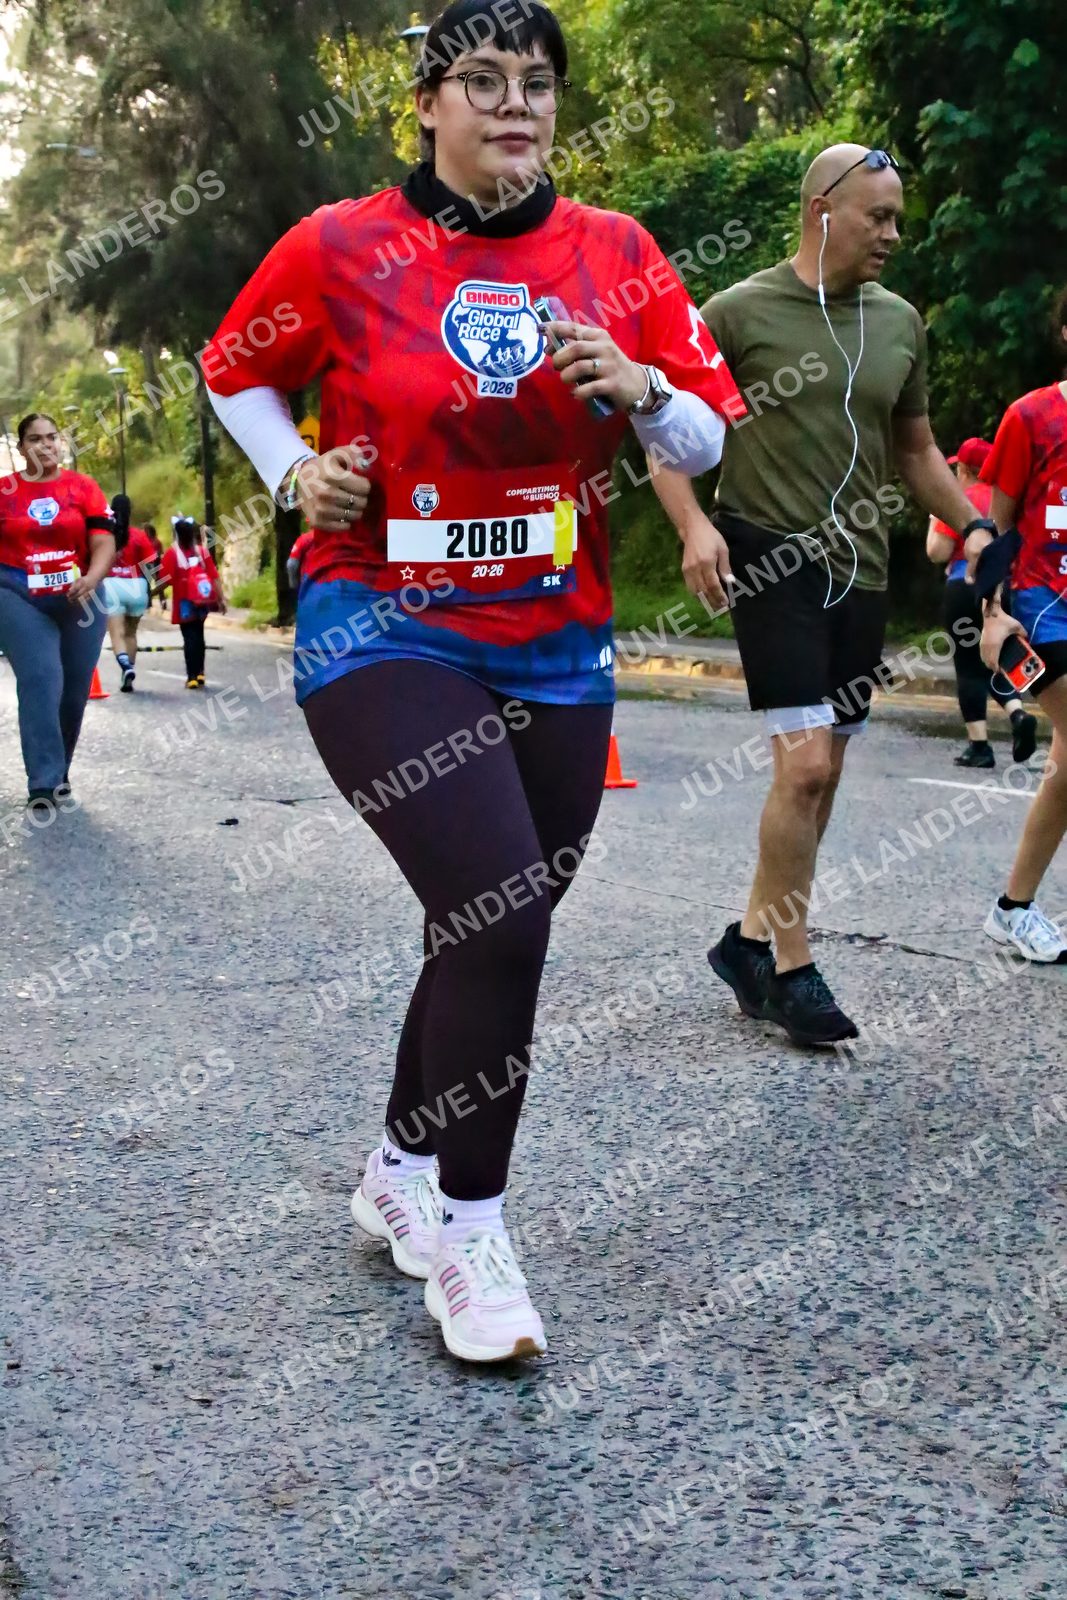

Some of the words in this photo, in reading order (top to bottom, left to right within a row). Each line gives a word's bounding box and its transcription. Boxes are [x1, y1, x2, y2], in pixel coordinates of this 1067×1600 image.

[466, 291, 520, 306] BIMBO
[468, 310, 520, 329] Global
[458, 324, 500, 340] Race
[481, 380, 514, 395] 2026
[506, 484, 560, 497] COMPARTIMOS
[446, 518, 528, 559] 2080
[44, 571, 68, 586] 3206
[542, 575, 561, 587] 5K
